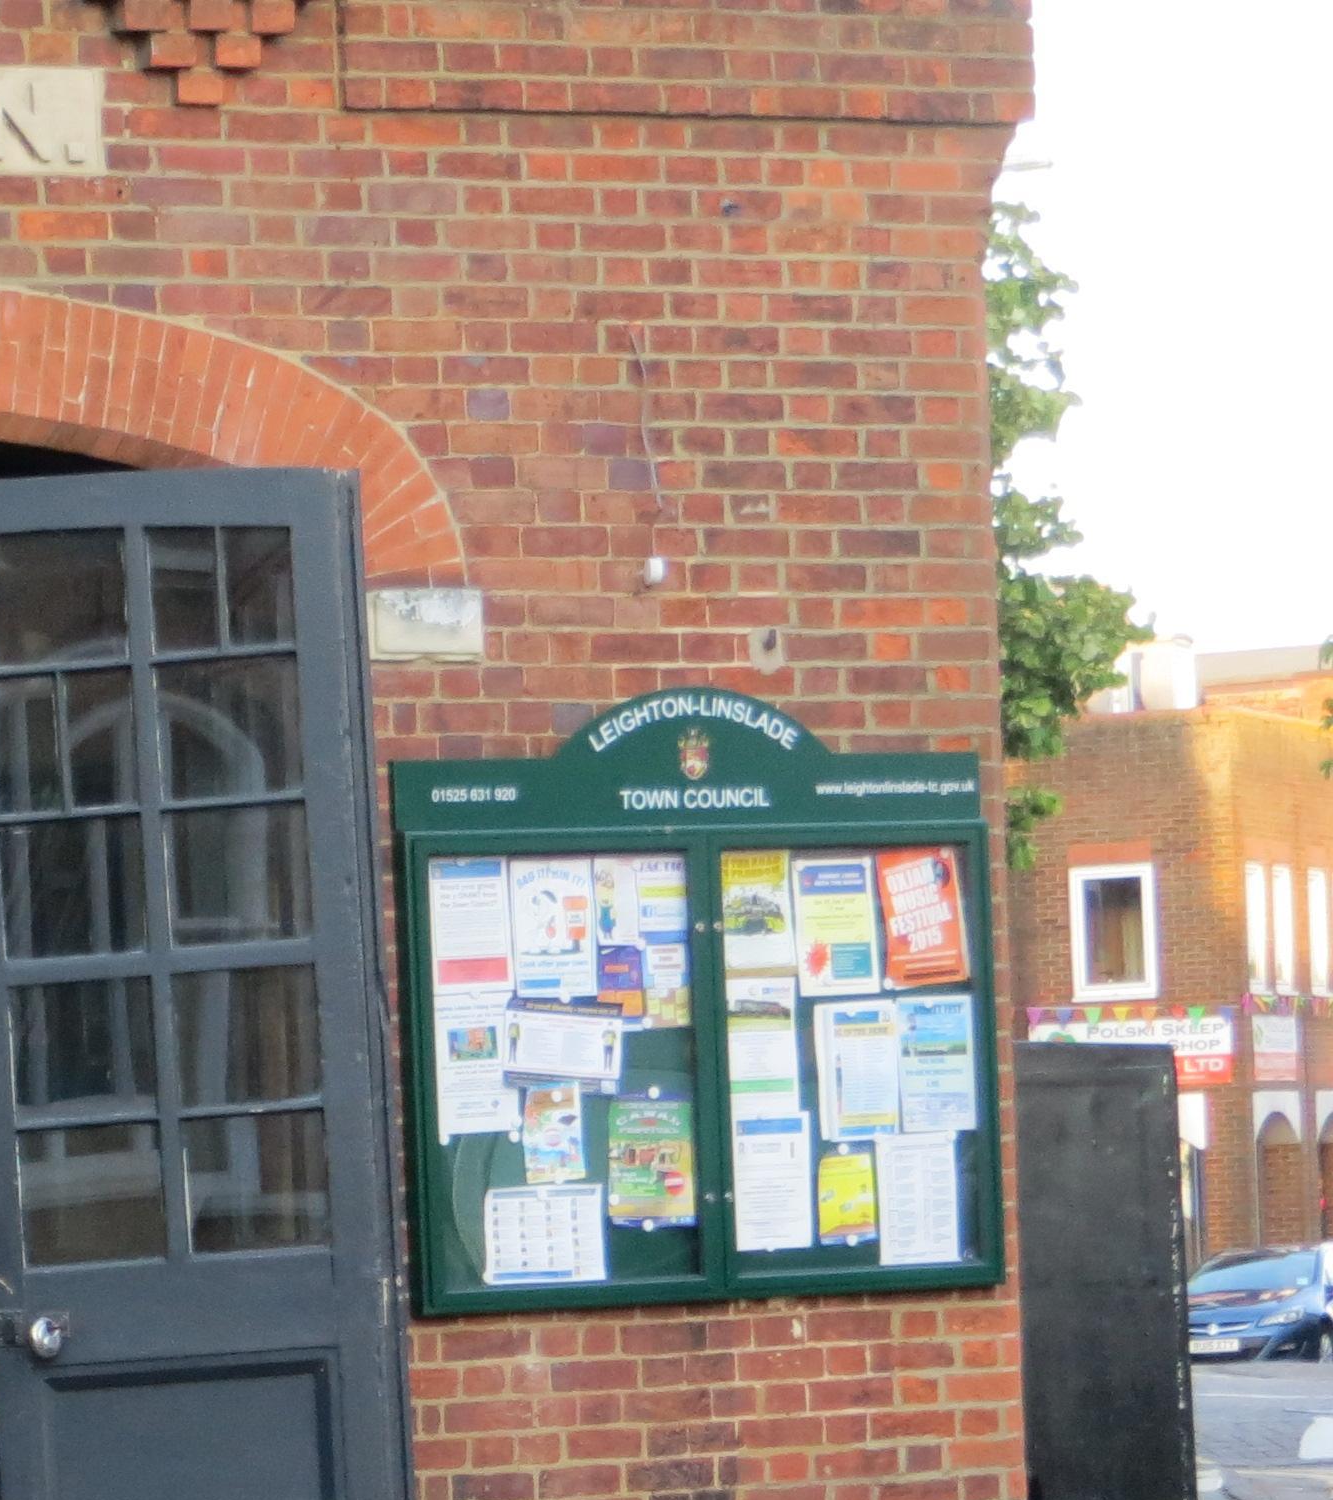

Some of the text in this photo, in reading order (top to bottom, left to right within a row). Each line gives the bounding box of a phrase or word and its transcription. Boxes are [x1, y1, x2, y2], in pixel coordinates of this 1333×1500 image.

[588, 695, 798, 752] LEIGHTON-LINSLADE
[432, 787, 516, 802] 01525 631 920
[620, 789, 770, 810] TOWN COUNCIL
[1162, 1023, 1224, 1036] SKLEP
[1184, 1058, 1225, 1073] LTD
